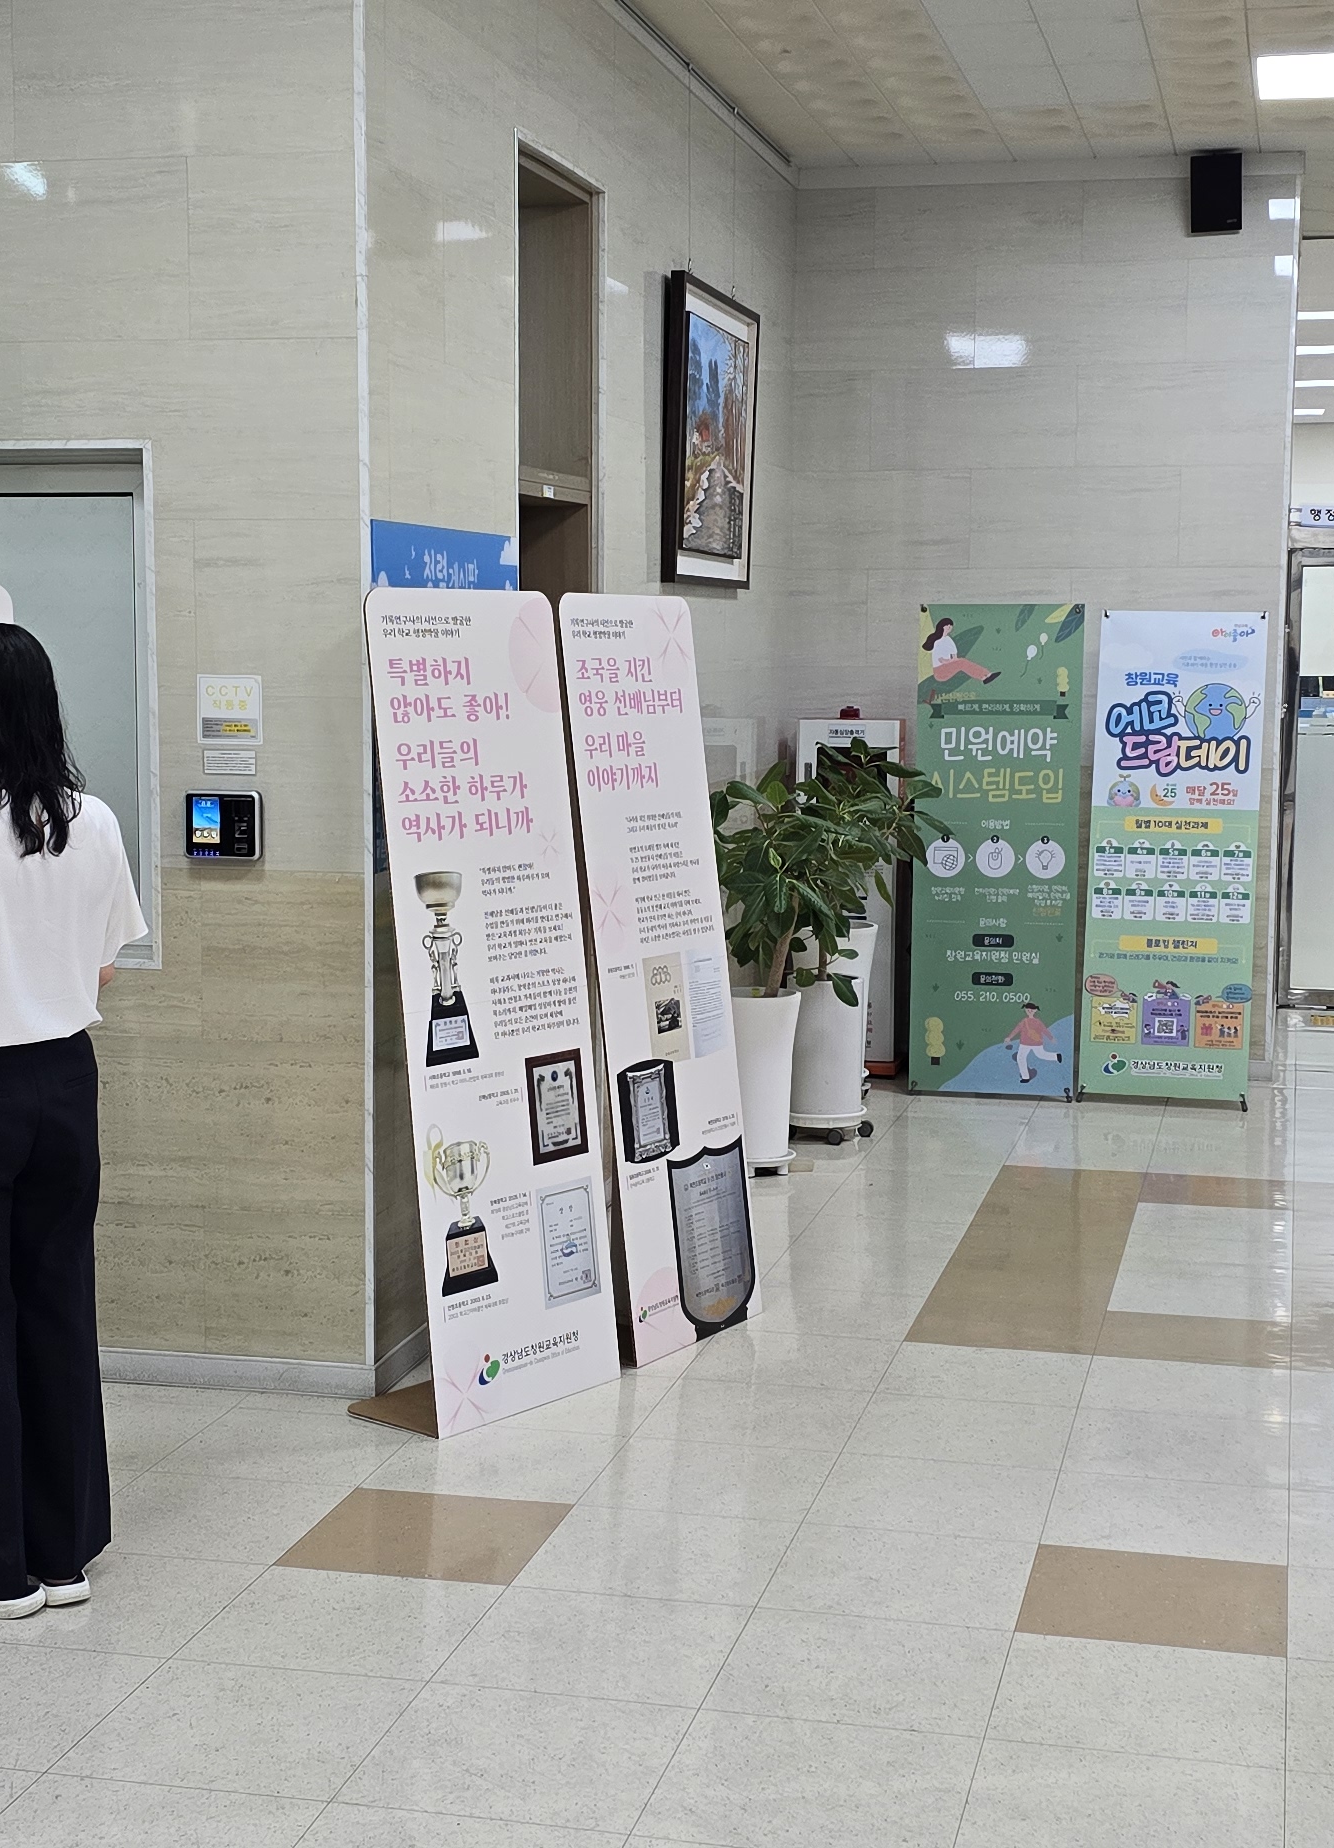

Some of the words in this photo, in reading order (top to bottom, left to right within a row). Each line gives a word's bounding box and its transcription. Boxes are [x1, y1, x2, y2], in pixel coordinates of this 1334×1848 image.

[387, 657, 471, 686] 특별하지
[575, 657, 621, 684] 조국을
[624, 656, 654, 683] 지킨
[1124, 670, 1181, 688] 창원교육
[205, 684, 253, 698] CCTV
[578, 689, 609, 717] 영웅
[614, 688, 683, 716] 선배님부터
[390, 694, 456, 724] 않아도
[463, 692, 509, 722] 좋아!
[1107, 691, 1178, 737] 에코
[396, 738, 479, 770] 우리들의
[584, 731, 613, 760] 우리
[616, 730, 646, 758] 마을
[941, 727, 1057, 762] 민원예약
[1118, 734, 1251, 776] 드림데이
[398, 776, 460, 804] 소소한
[467, 772, 527, 802] 하루가
[587, 762, 658, 792] 이야기까지
[930, 767, 1064, 803] 시스템도입
[1162, 787, 1177, 798] 25
[402, 811, 467, 842] 역사가
[475, 806, 533, 836] 되니까
[502, 1330, 578, 1364] 경상남도창원교육지원청
